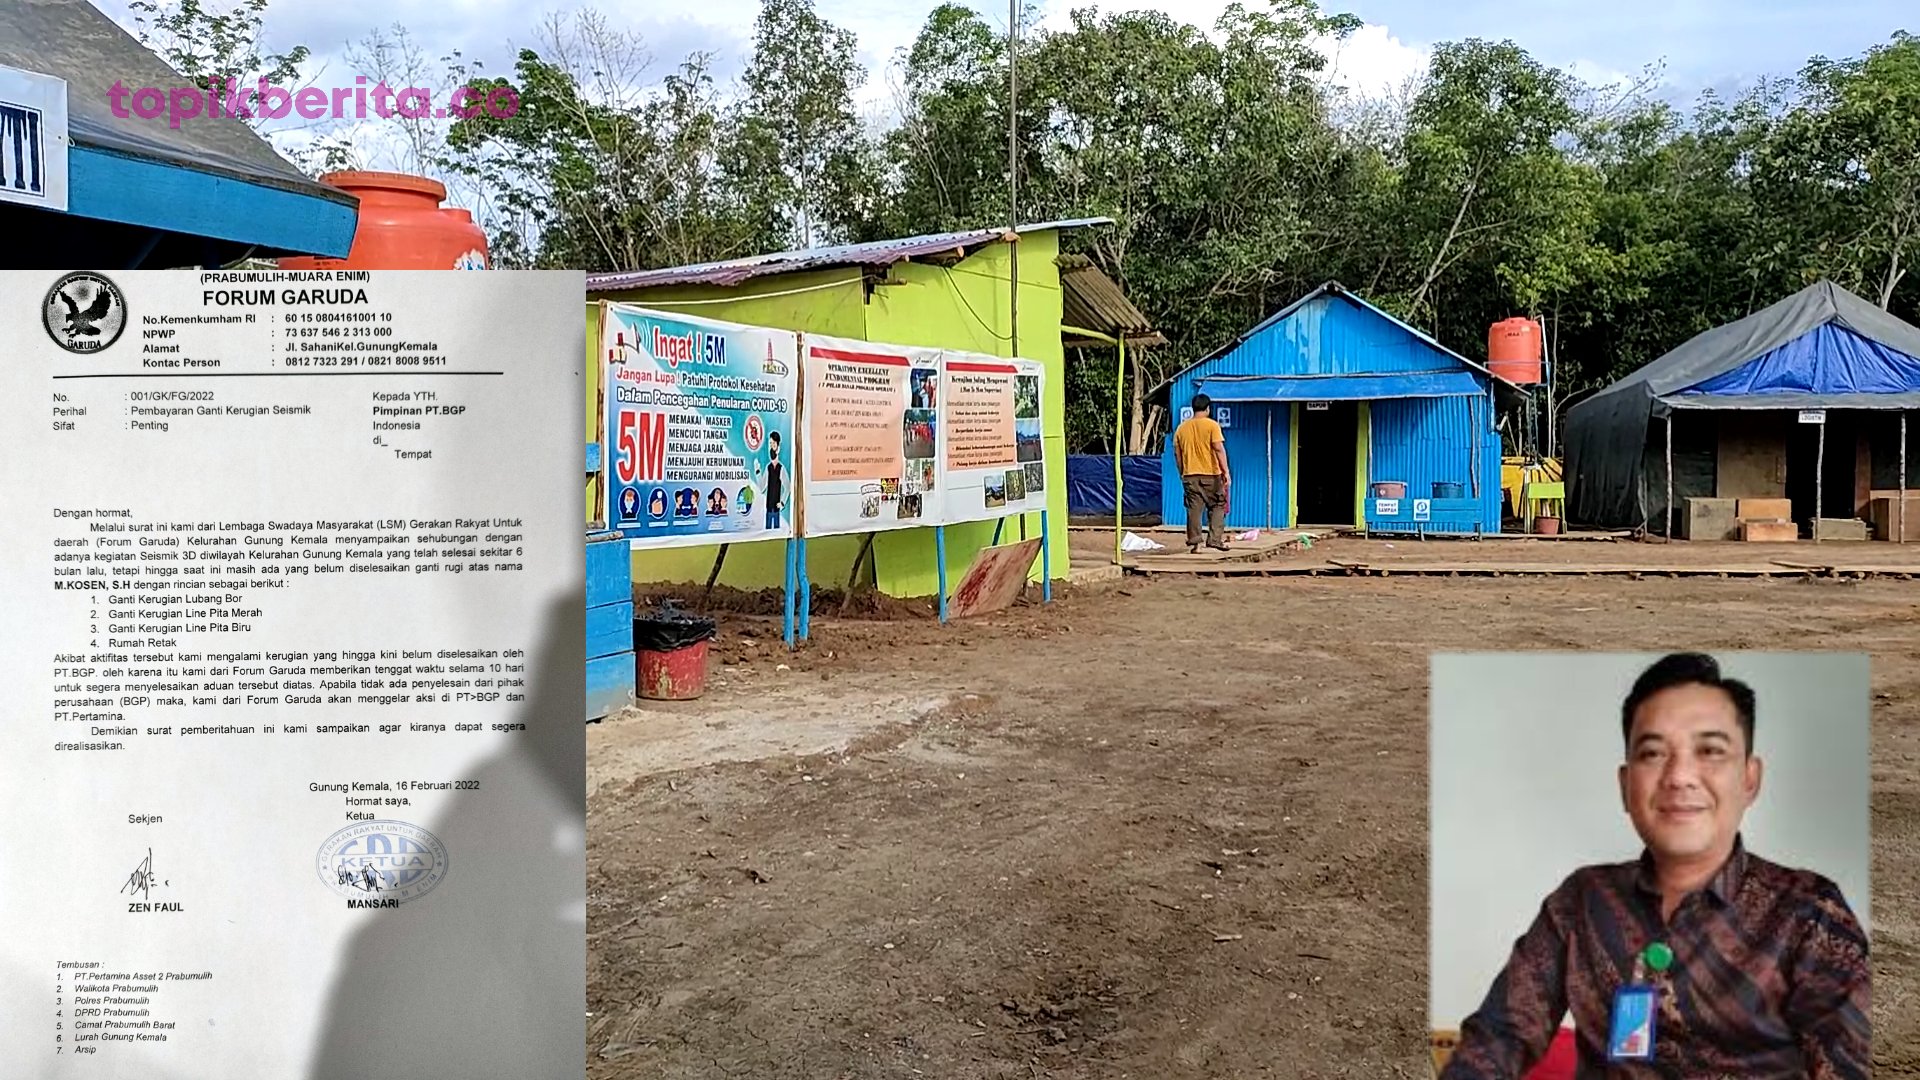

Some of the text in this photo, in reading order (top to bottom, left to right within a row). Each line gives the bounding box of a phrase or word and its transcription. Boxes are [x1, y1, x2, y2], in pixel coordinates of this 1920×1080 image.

[200, 271, 370, 285] (PRABUMULIH-MUARA ENIM)
[203, 288, 368, 306] FORUM GARUDA
[142, 313, 255, 324] No.Kemenkumham RI
[284, 312, 392, 323] 60 15 0804161001 10
[142, 329, 175, 339] NPWP
[284, 326, 392, 337] 73 637 546 2 313 000
[67, 339, 102, 349] GARUDA
[142, 344, 180, 353] Alamat
[285, 341, 437, 353] Jl. SahaniKel.GunungKemala
[654, 327, 693, 367] Ingat
[705, 335, 726, 365] 5M
[142, 357, 220, 368] Kontac Person
[285, 355, 446, 366] 0812 7323 291 / 0821 8008 9511
[858, 367, 889, 376] EXCELLENT
[617, 367, 652, 384] Jangan
[655, 371, 675, 387] Lupa
[682, 373, 707, 387] Patuhi
[709, 377, 738, 389] Protokol
[741, 379, 776, 392] Kesehatan
[864, 376, 890, 385] PROGRAM
[52, 392, 69, 402] No.
[130, 390, 214, 401] 001/GK/FG/2022
[372, 390, 437, 403] Kepada YTH.
[617, 386, 787, 412] Dalam Pencegahan Penularan COVID-19
[52, 406, 86, 416] Perihal
[130, 404, 311, 417] Pembayaran Ganti Kerugian Seismik
[372, 405, 466, 417] Pimpinan PT.BGP
[52, 420, 75, 430] Sifat
[131, 420, 168, 432] Penting
[372, 420, 420, 430] Indonesia
[669, 414, 731, 427] MEMAKAI MASKER
[669, 430, 728, 440] MENCUCI TANGAN
[618, 411, 665, 482] 5M
[669, 442, 724, 454] MENJAGA JARAK
[394, 448, 432, 461] Tempat
[667, 456, 744, 467] MENJAUHI KERUMUNAN
[666, 471, 750, 482] MENGURANGI MOBILISASI
[53, 508, 132, 520] Dengan hormat,
[90, 517, 522, 533] Melalui surat ini kami dari Lembaga Swadaya Masyarakat (LSM) Gerakan Rakyat Untuk
[54, 578, 284, 591] M.KOSEN, S.H dengan rincian sebagai berikut
[91, 593, 242, 606] 1. Ganti Kerugian Lubang Bor
[54, 710, 125, 721] PT.Pertamina.
[54, 740, 125, 751] direalisasikan.
[309, 780, 479, 794] Gunung Kemala, 16 Februari 2022
[345, 796, 410, 807] Hormat saya,
[128, 813, 162, 825] Sekjen
[346, 810, 374, 820] Ketua
[341, 856, 424, 868] KETUA
[128, 902, 184, 912] ZEN FAUL
[347, 899, 399, 909] MANSARI
[56, 960, 100, 968] Tembusan
[56, 971, 212, 981] 1. PT.Pertamina Asset 2 Prabumulih
[56, 995, 149, 1005] 3. Polres Prabumulih
[56, 1032, 167, 1043] 6. Lurah Gunung Kemala
